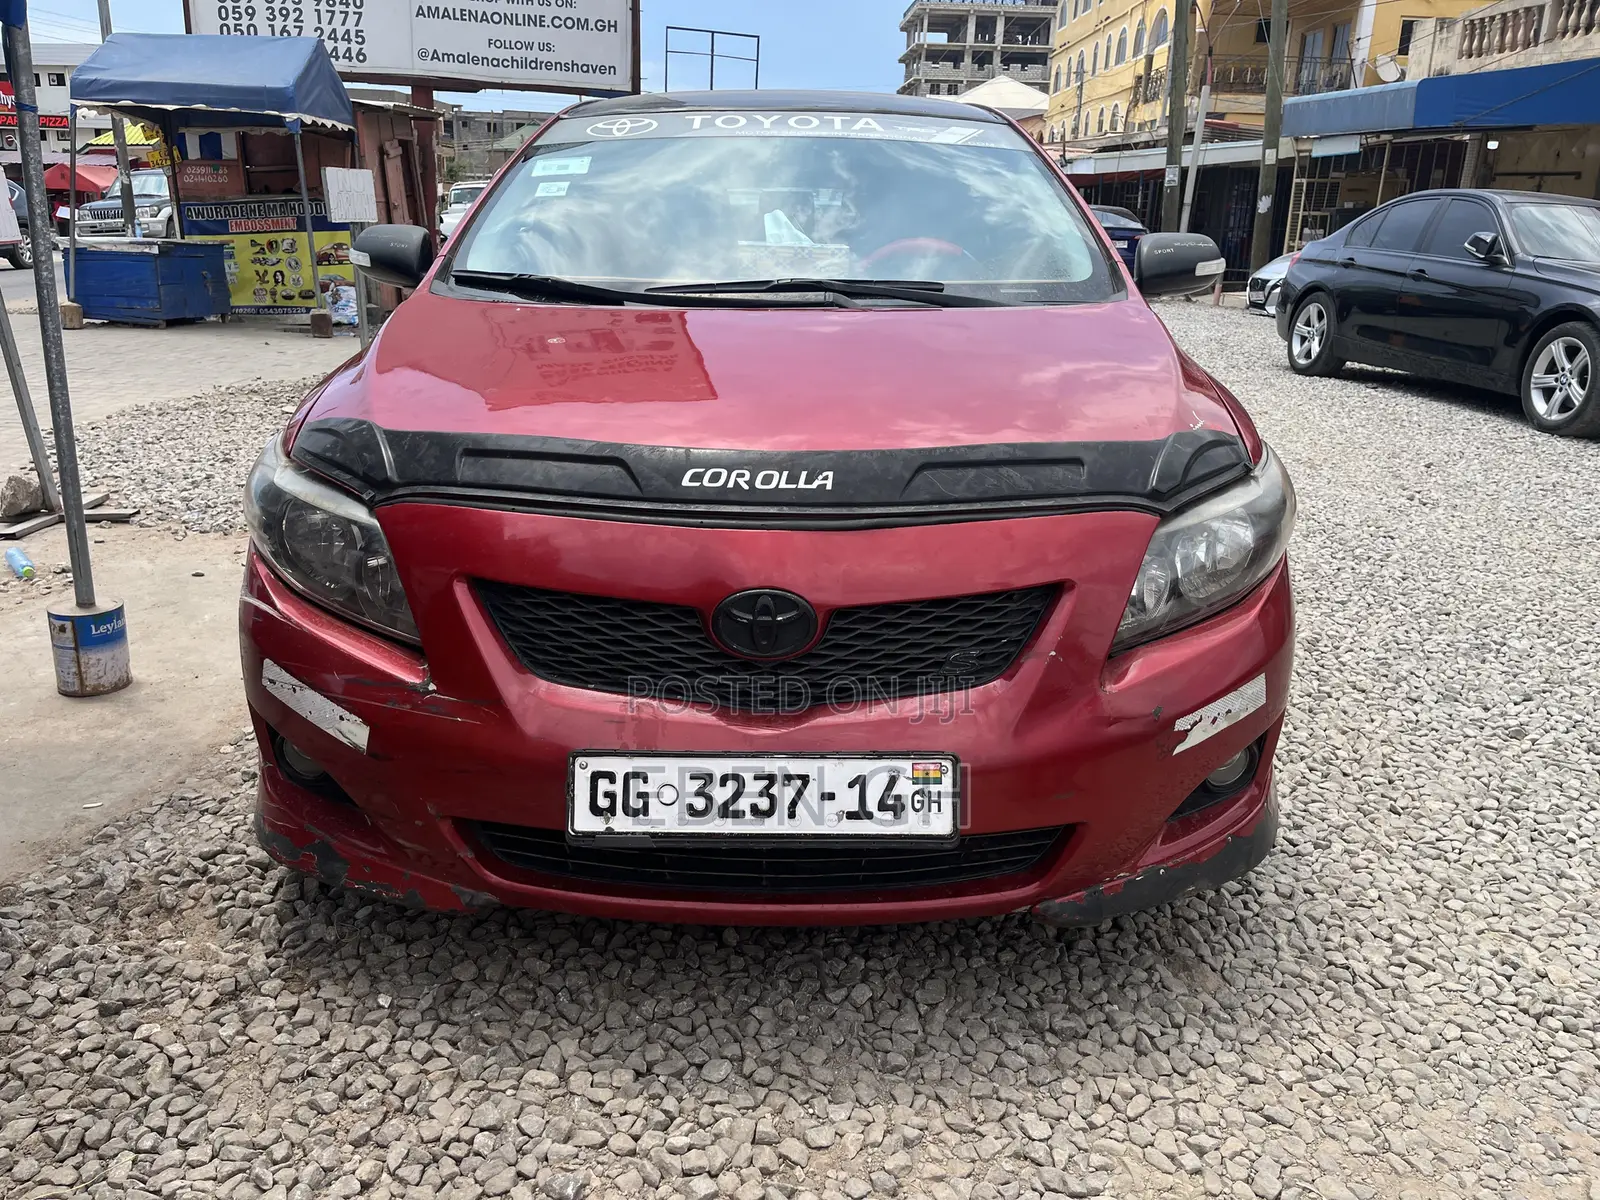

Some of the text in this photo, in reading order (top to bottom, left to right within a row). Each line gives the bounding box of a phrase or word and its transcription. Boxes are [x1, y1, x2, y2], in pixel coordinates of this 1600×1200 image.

[555, 0, 577, 9] ON:
[217, 5, 363, 27] 059 392 1777
[414, 4, 618, 33] AMALENAONLINE.COM.GH
[313, 26, 366, 45] 2445
[487, 38, 556, 53] FOLLOW US:
[417, 47, 617, 75] @Amalenachildrenshaven
[39, 116, 69, 127] PIZZA
[685, 114, 885, 132] TOYOTA
[185, 204, 247, 220] AWURADE
[247, 204, 265, 218] NE
[265, 202, 287, 217] MA
[228, 217, 297, 233] EMBOSSMENT
[1153, 247, 1175, 255] SPORT
[681, 467, 834, 491] COROLLA
[589, 770, 906, 820] GG 3237-14
[910, 788, 942, 813] GH
